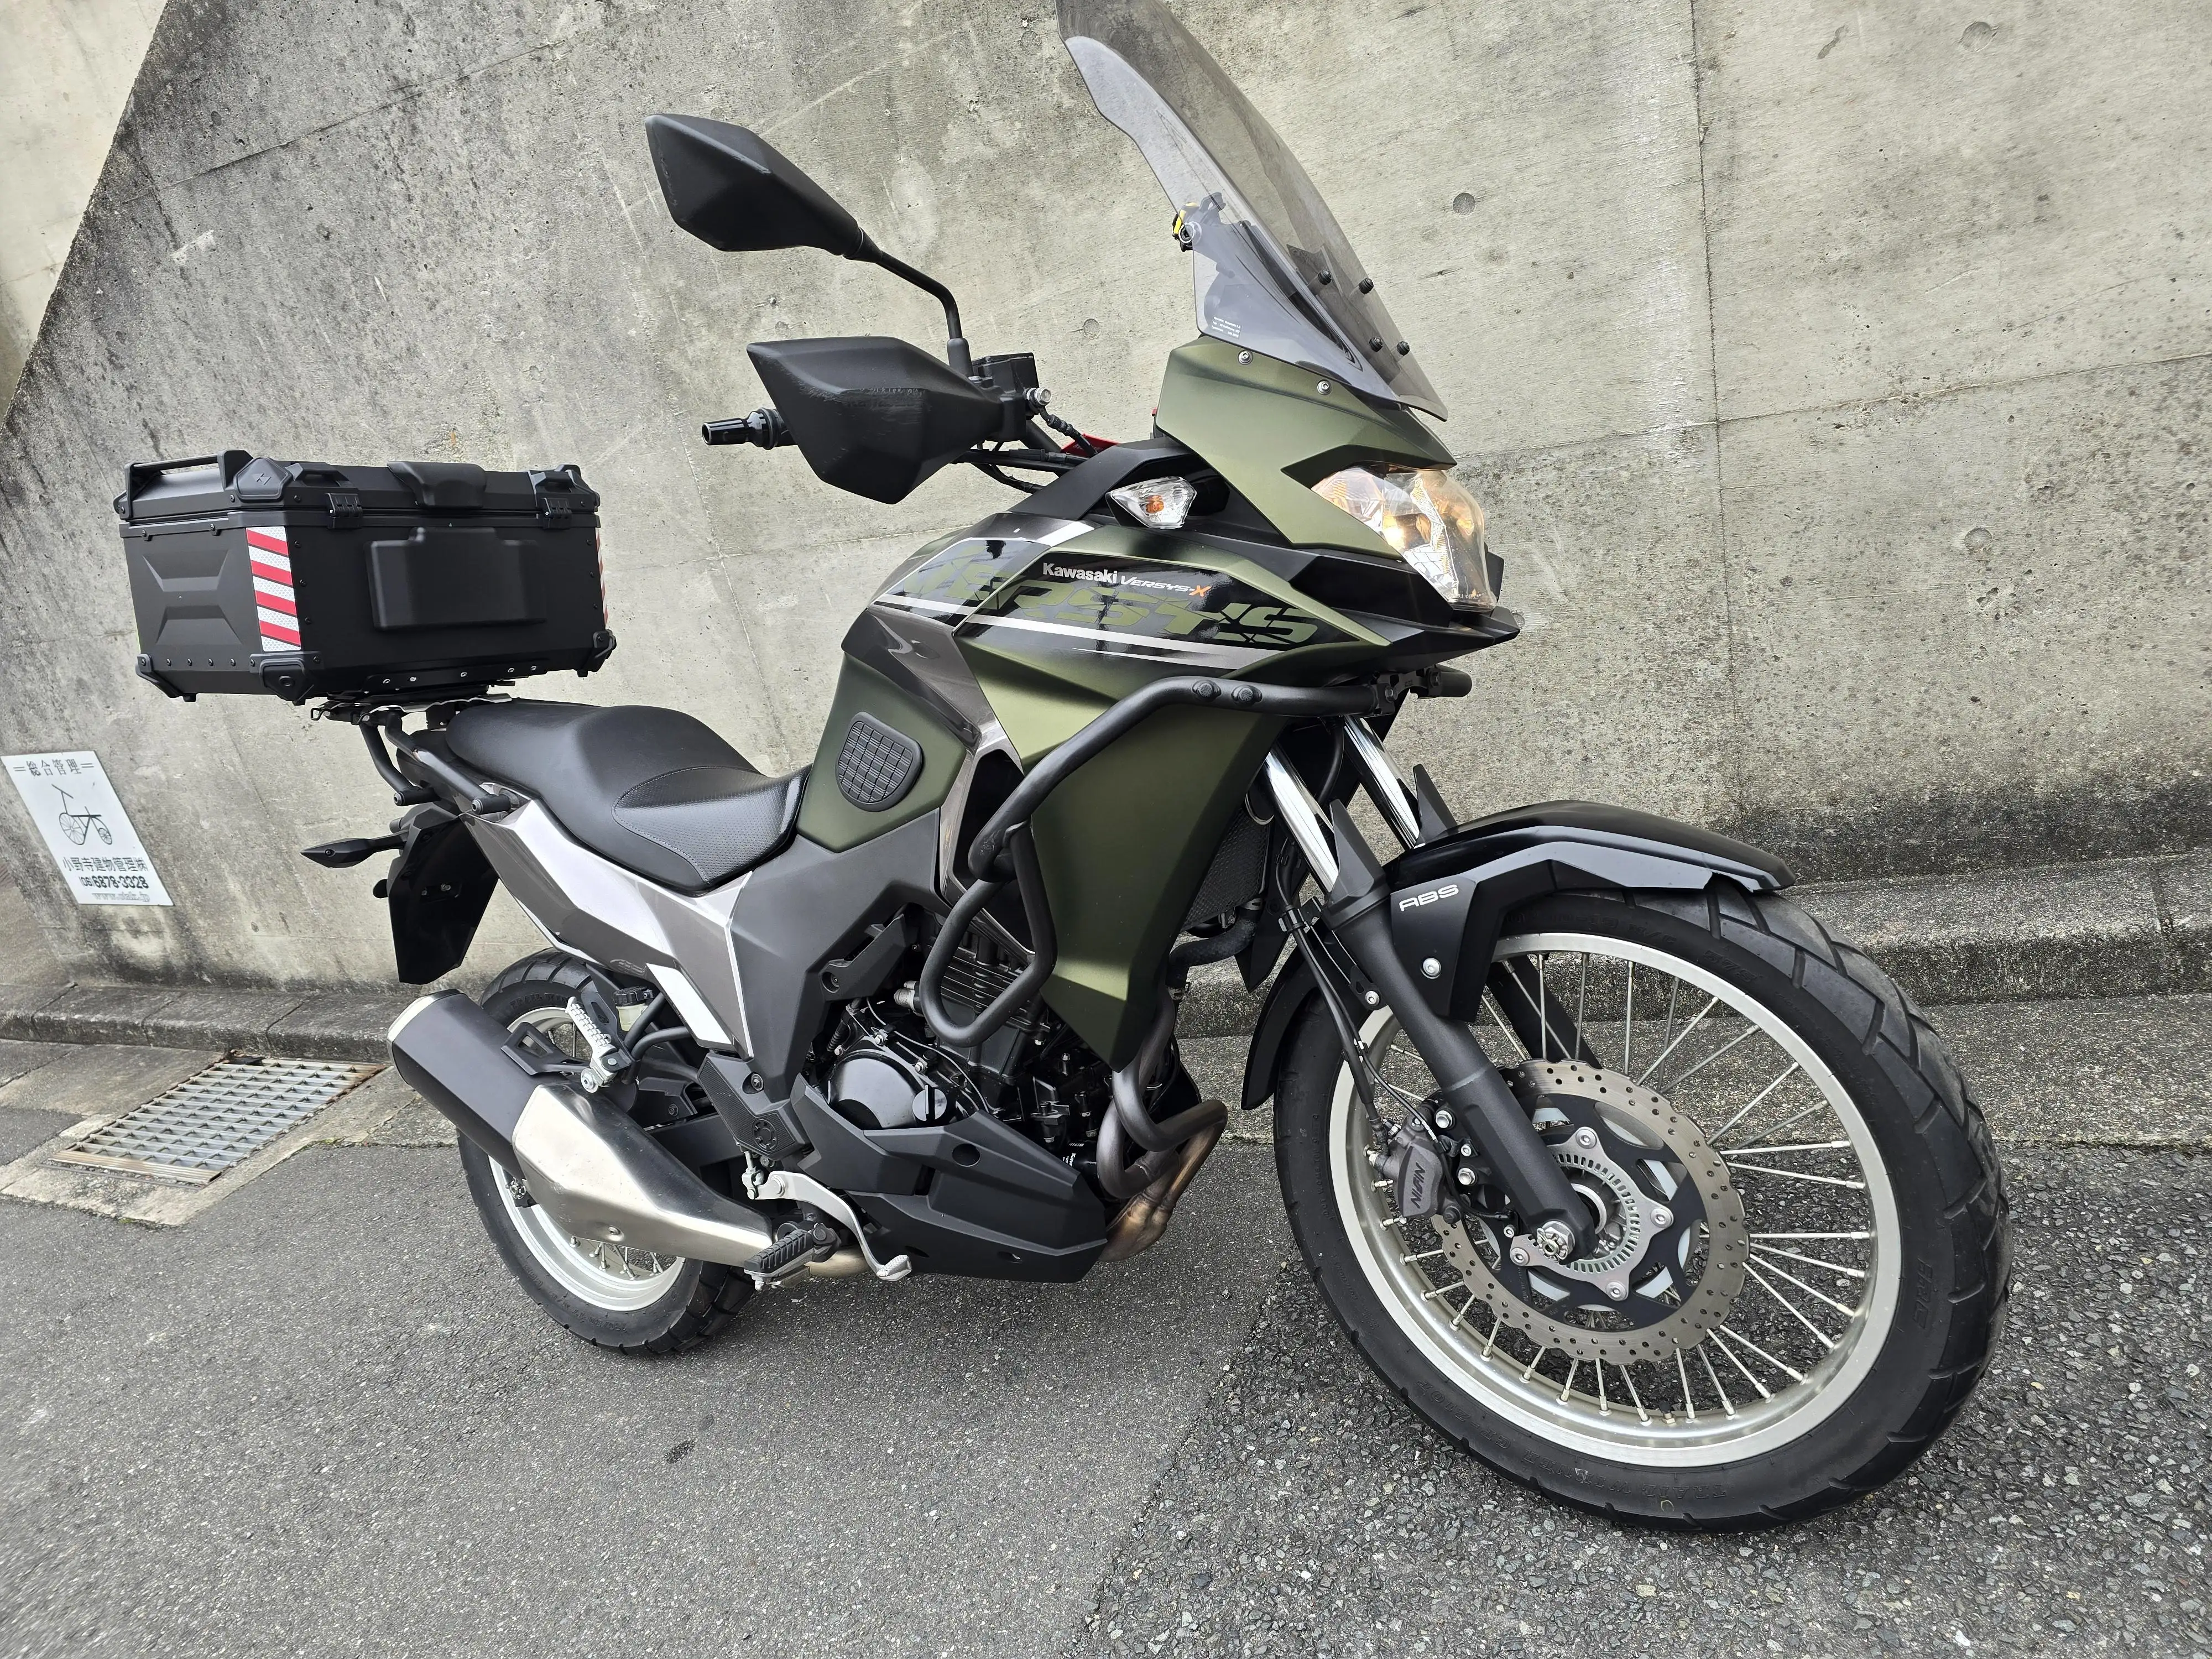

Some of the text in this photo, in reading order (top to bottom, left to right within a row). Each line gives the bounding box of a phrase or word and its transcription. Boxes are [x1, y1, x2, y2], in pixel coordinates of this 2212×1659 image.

[1043, 562, 1212, 597] Kawasaki VERSYS-X
[26, 759, 82, 776] 総合管理
[1399, 884, 1459, 911] ABS
[1521, 1449, 1631, 1493] WINNER
[1641, 1483, 1726, 1499] TRAIL
